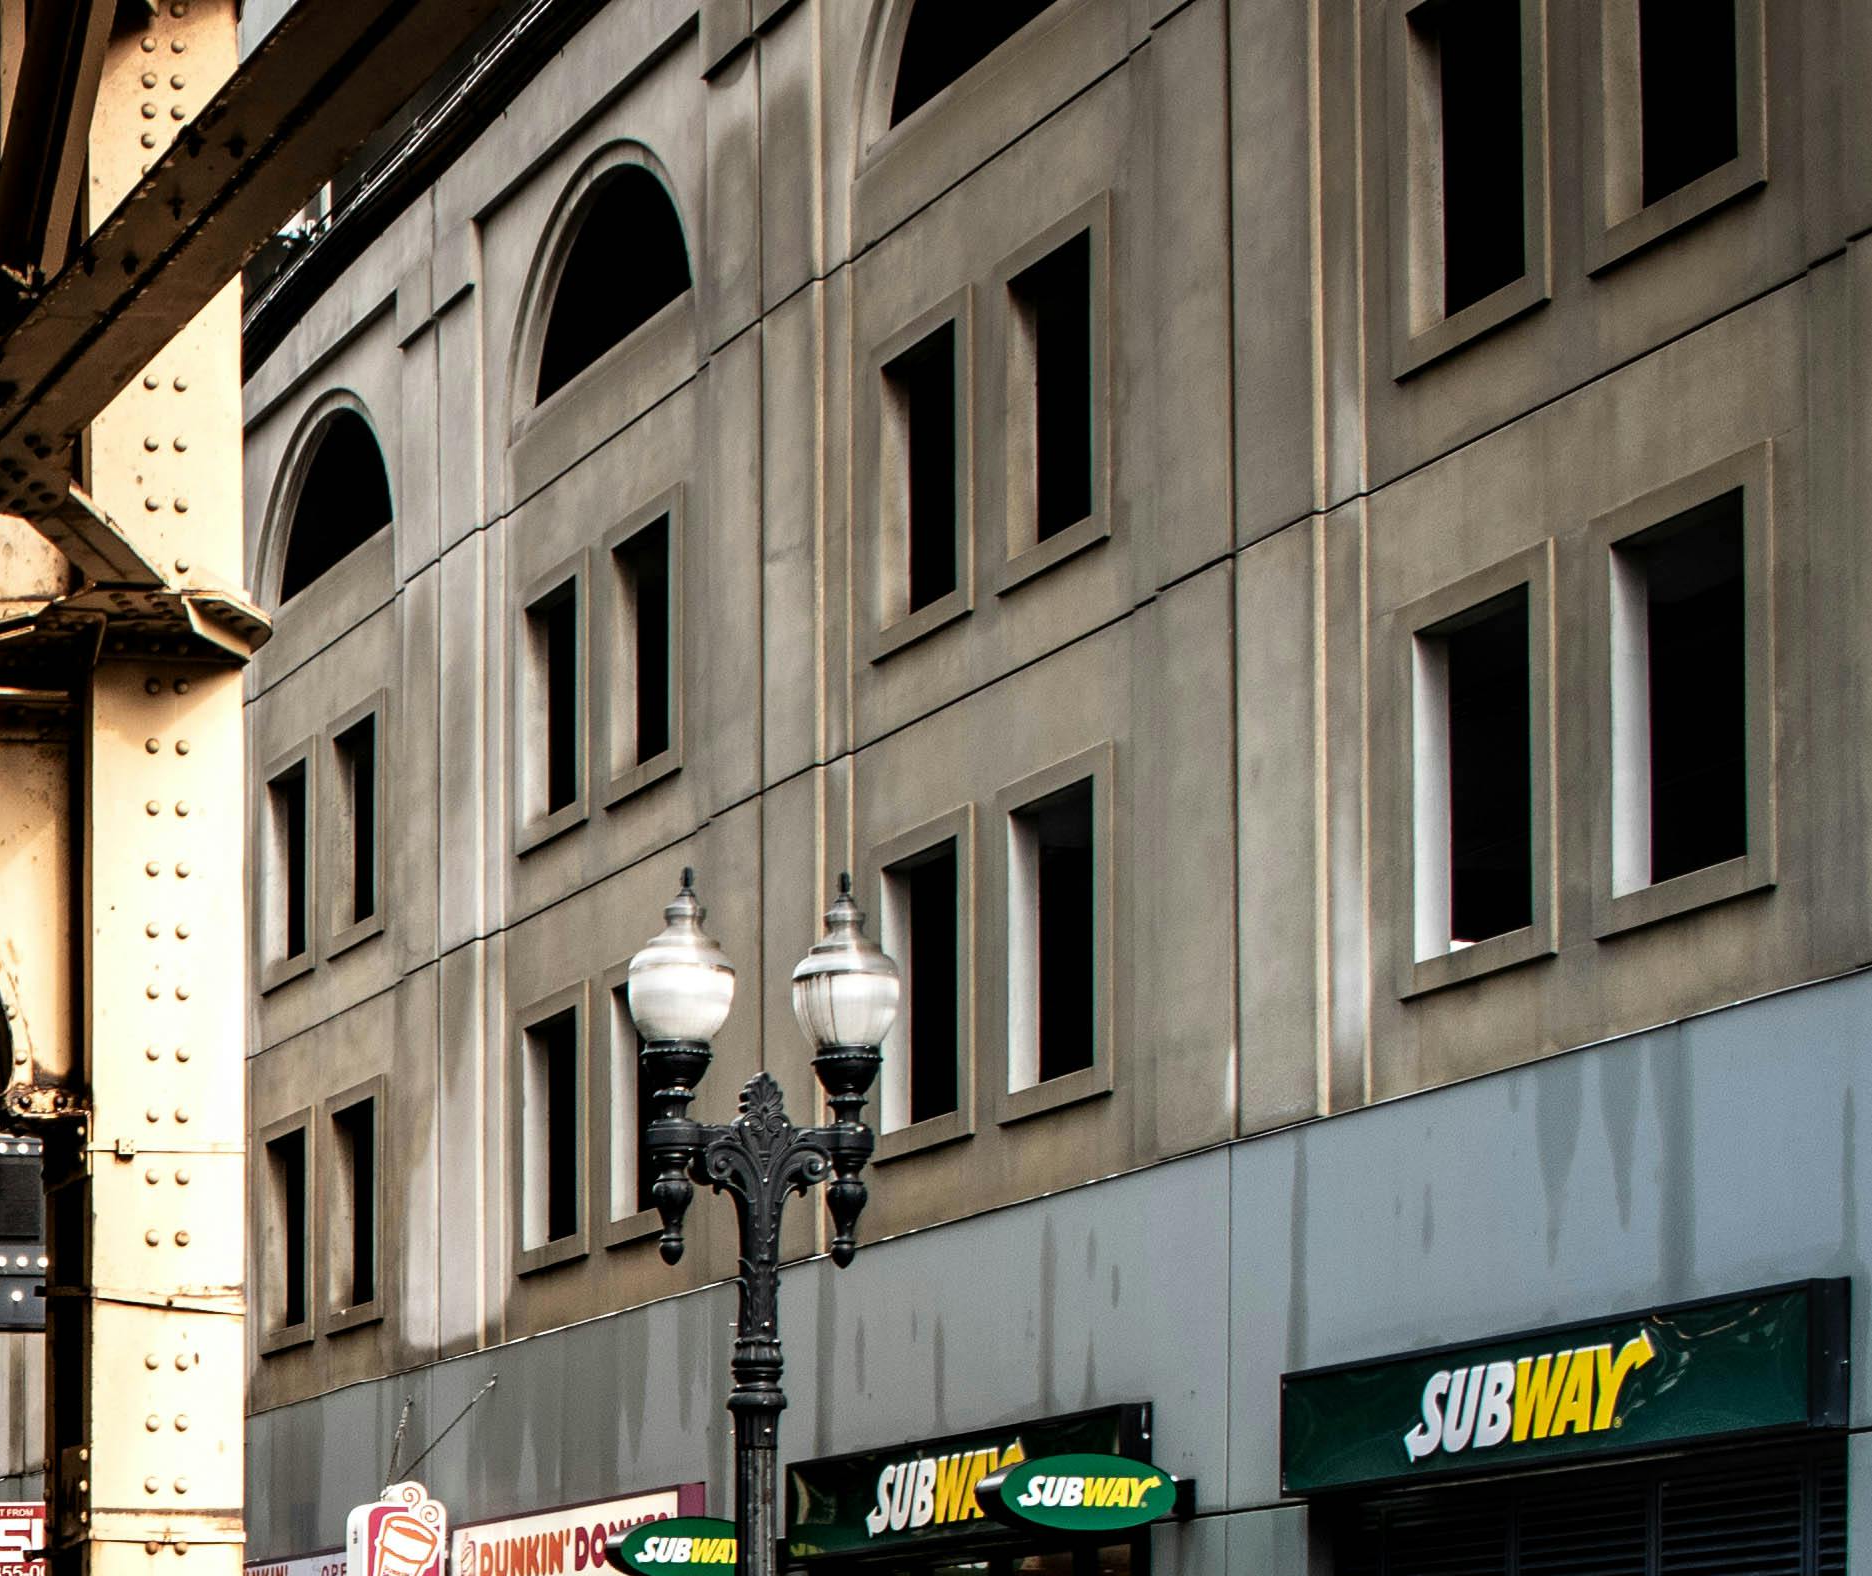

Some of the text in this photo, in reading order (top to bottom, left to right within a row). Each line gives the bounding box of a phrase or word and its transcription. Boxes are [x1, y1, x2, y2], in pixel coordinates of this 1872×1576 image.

[1403, 1328, 1654, 1464] SUBWAY
[1016, 1475, 1162, 1509] SUBWAY
[7, 1508, 34, 1517] FROM
